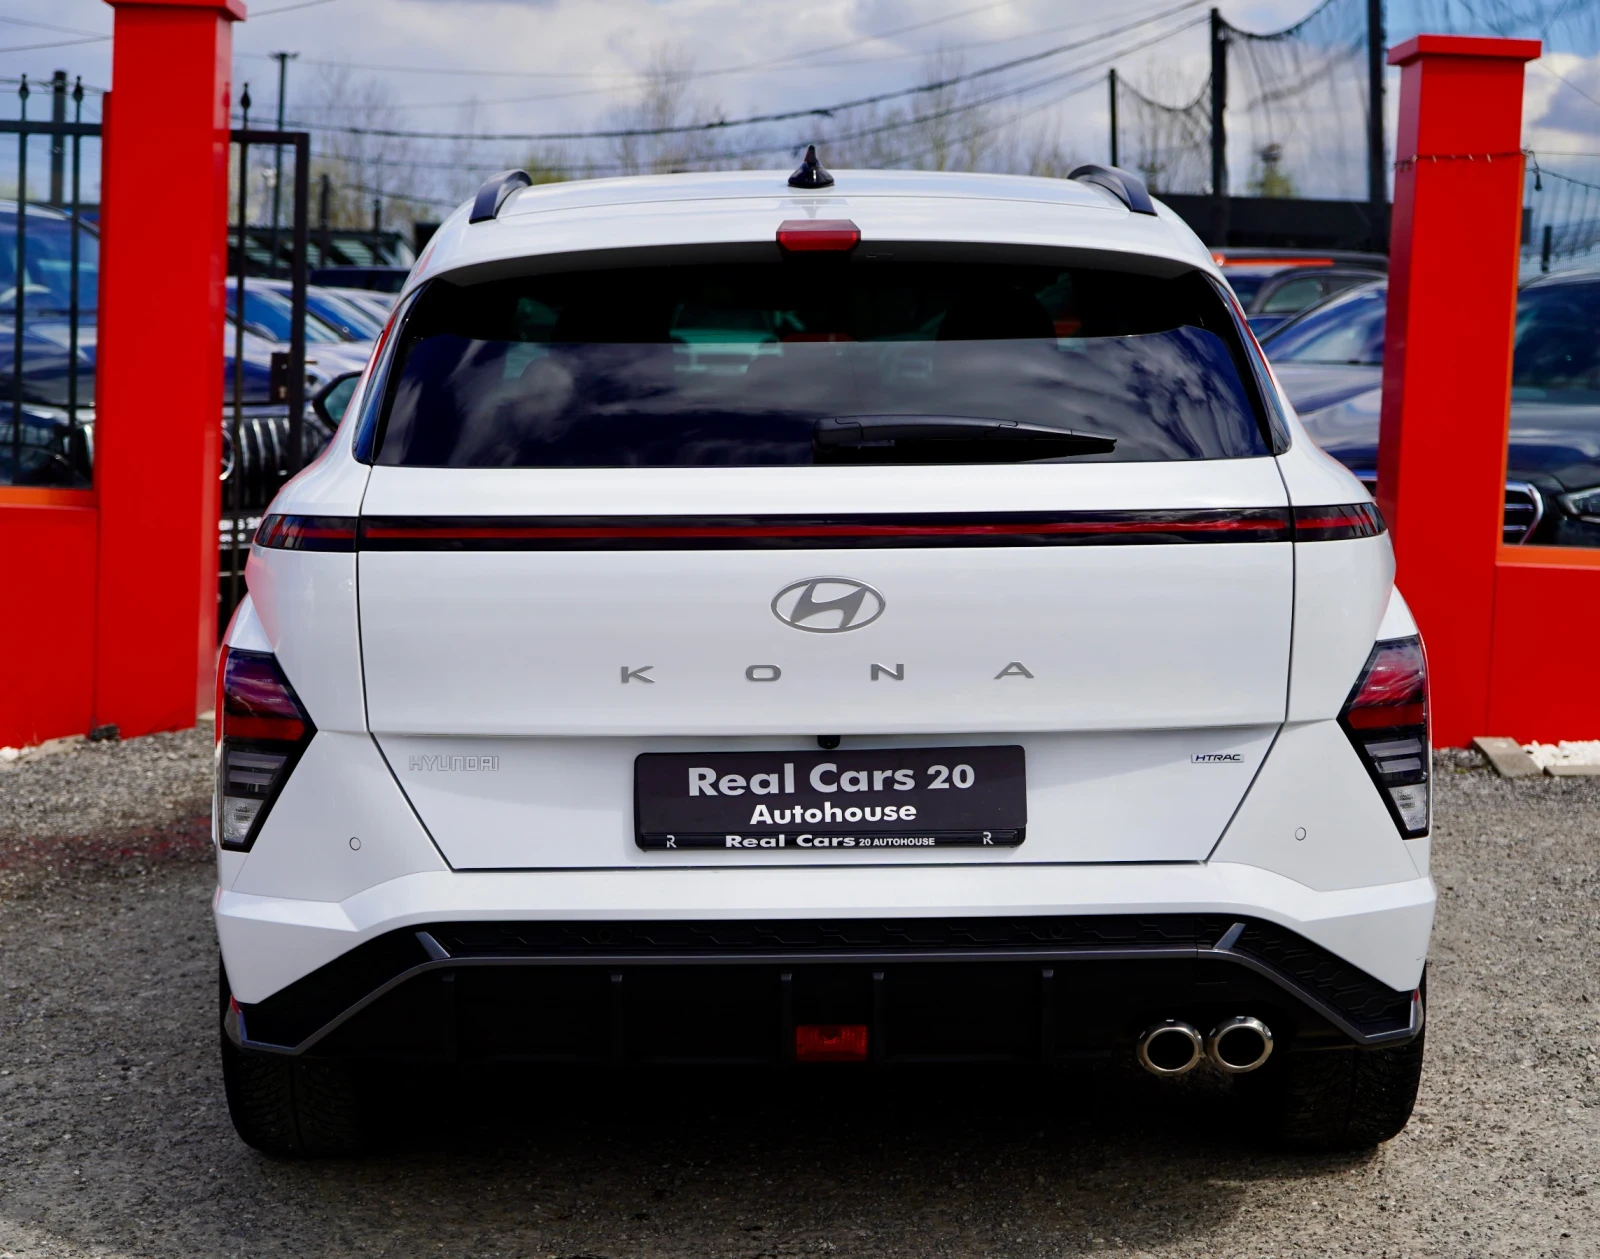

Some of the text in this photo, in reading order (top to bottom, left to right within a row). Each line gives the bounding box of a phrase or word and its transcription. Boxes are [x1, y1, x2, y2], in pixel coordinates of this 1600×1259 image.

[621, 660, 1035, 684] KONA
[409, 754, 499, 771] HYUNDAI
[1195, 753, 1241, 761] HTRAC
[688, 763, 976, 796] Real Cars 20
[749, 801, 917, 825] Autohouse
[725, 834, 936, 848] Real Cars 20 AUTOHOUSE
